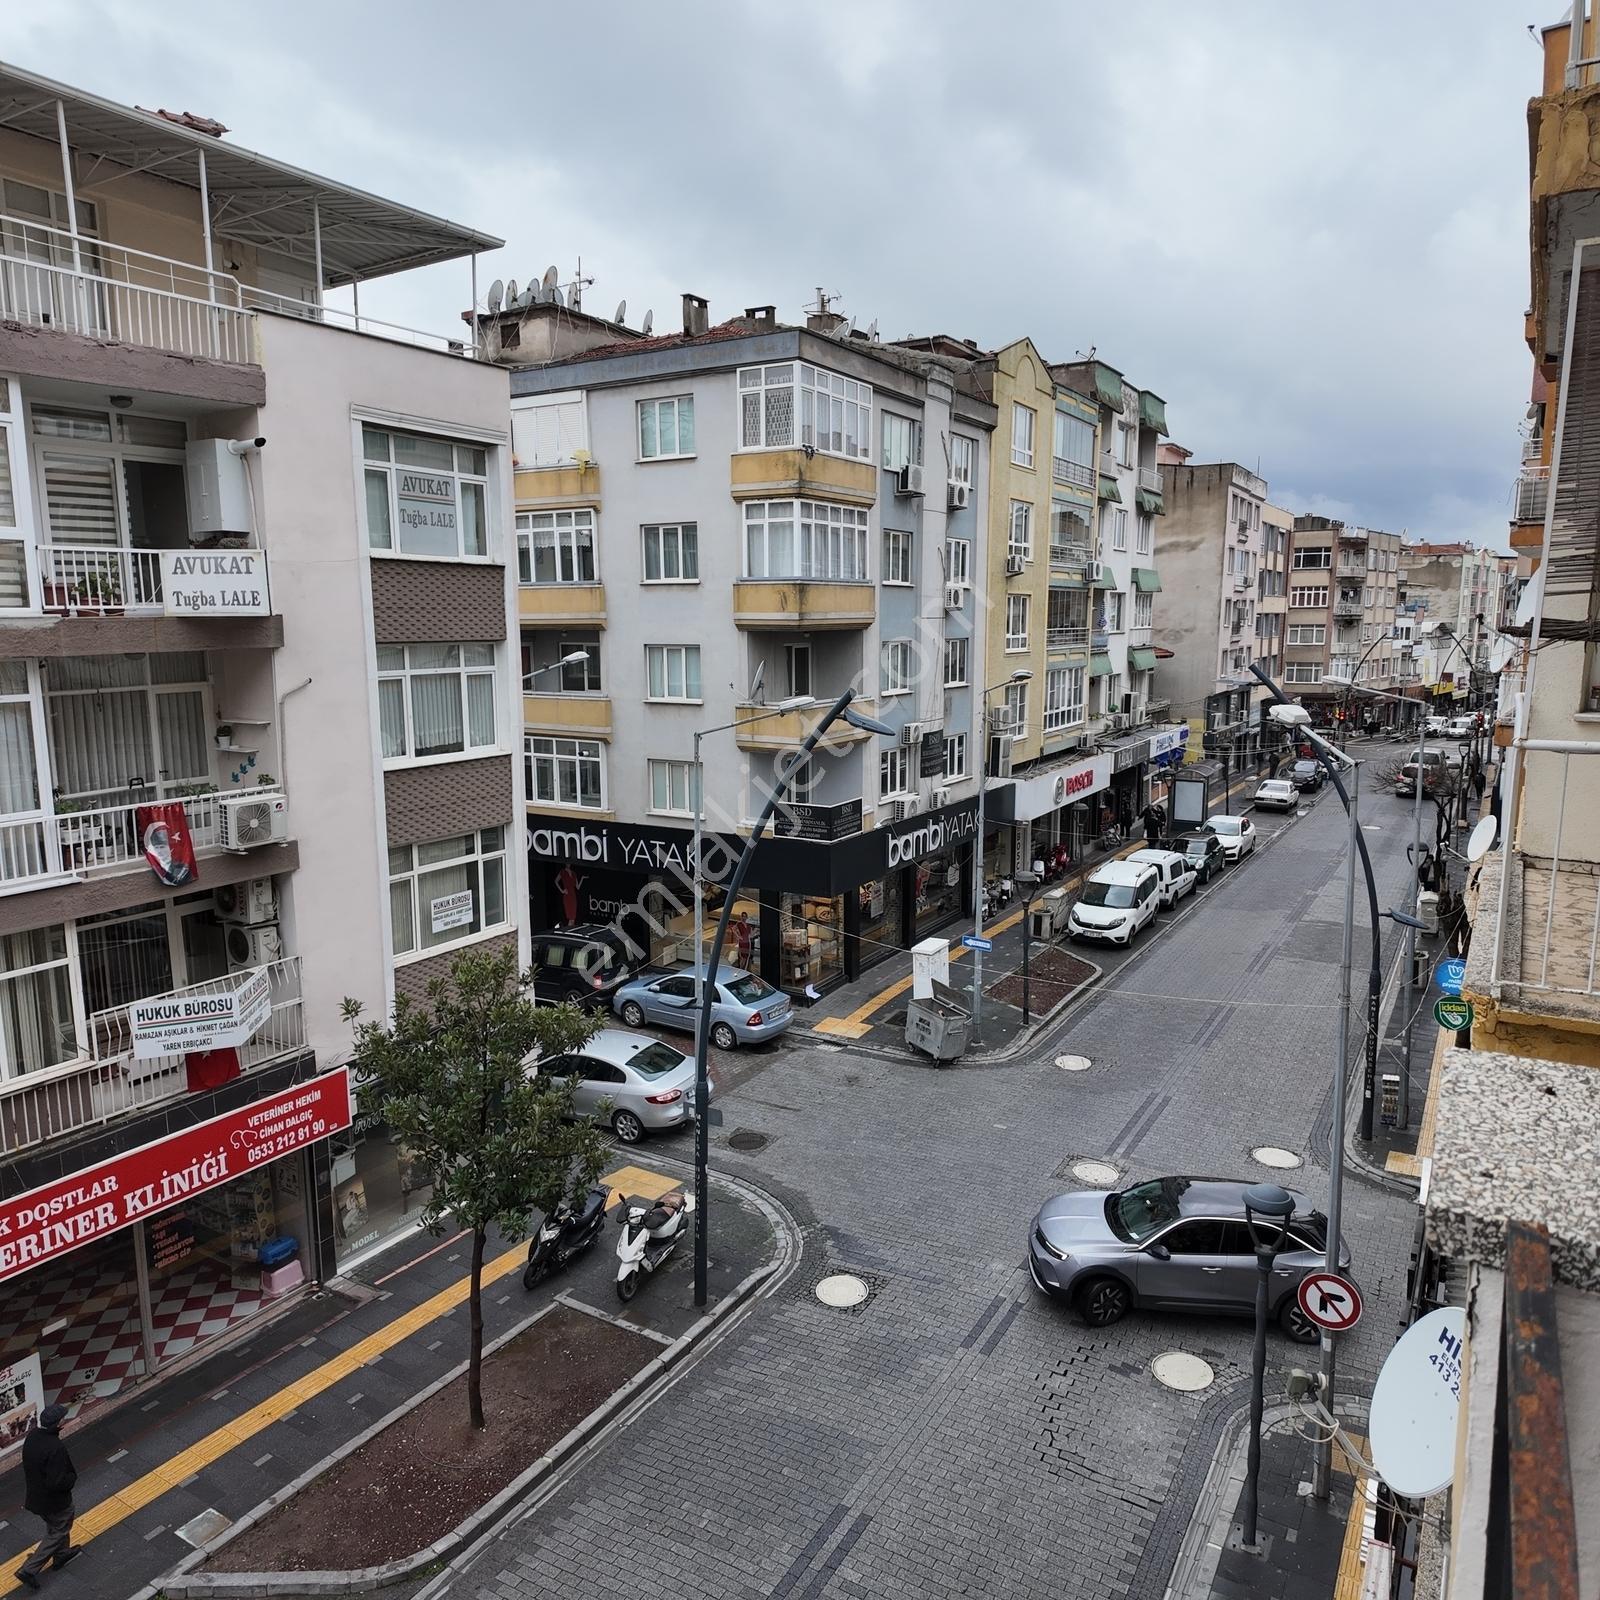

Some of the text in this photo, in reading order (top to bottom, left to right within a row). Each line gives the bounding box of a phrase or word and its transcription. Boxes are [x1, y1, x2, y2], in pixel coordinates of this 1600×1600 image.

[402, 475, 450, 496] AVUKAT
[400, 508, 454, 528] Tuğba LALE
[172, 556, 254, 575] AVUKAT
[172, 590, 261, 611] Tuğba LALE
[1066, 770, 1093, 796] BOSCH
[792, 806, 812, 817] BSD
[886, 814, 944, 868] bambi
[944, 808, 981, 842] YATAK
[617, 836, 697, 872] YATAK
[136, 1004, 181, 1022] HUKUK
[184, 997, 233, 1017] BÜROSU
[1441, 1003, 1466, 1012] iddaa
[135, 1029, 163, 1041] RAMAZAN
[164, 1027, 188, 1039] AŞIKLAR
[189, 1025, 194, 1033] &
[219, 1019, 238, 1031] ÇAĞAN
[162, 1041, 182, 1051] YAREN
[248, 1089, 321, 1128] VETERİNER HEKİM
[259, 1121, 284, 1139] CİHAN
[285, 1109, 313, 1128] DALGIÇ
[248, 1140, 275, 1163] 0533
[277, 1131, 296, 1151] 212
[298, 1125, 310, 1141] 81
[312, 1118, 325, 1135] 90
[124, 1146, 228, 1219] KLİNİĞİ
[16, 1175, 119, 1229] DOSTLAR
[351, 1230, 380, 1251] MODEL
[1429, 1354, 1461, 1402] 413 2
